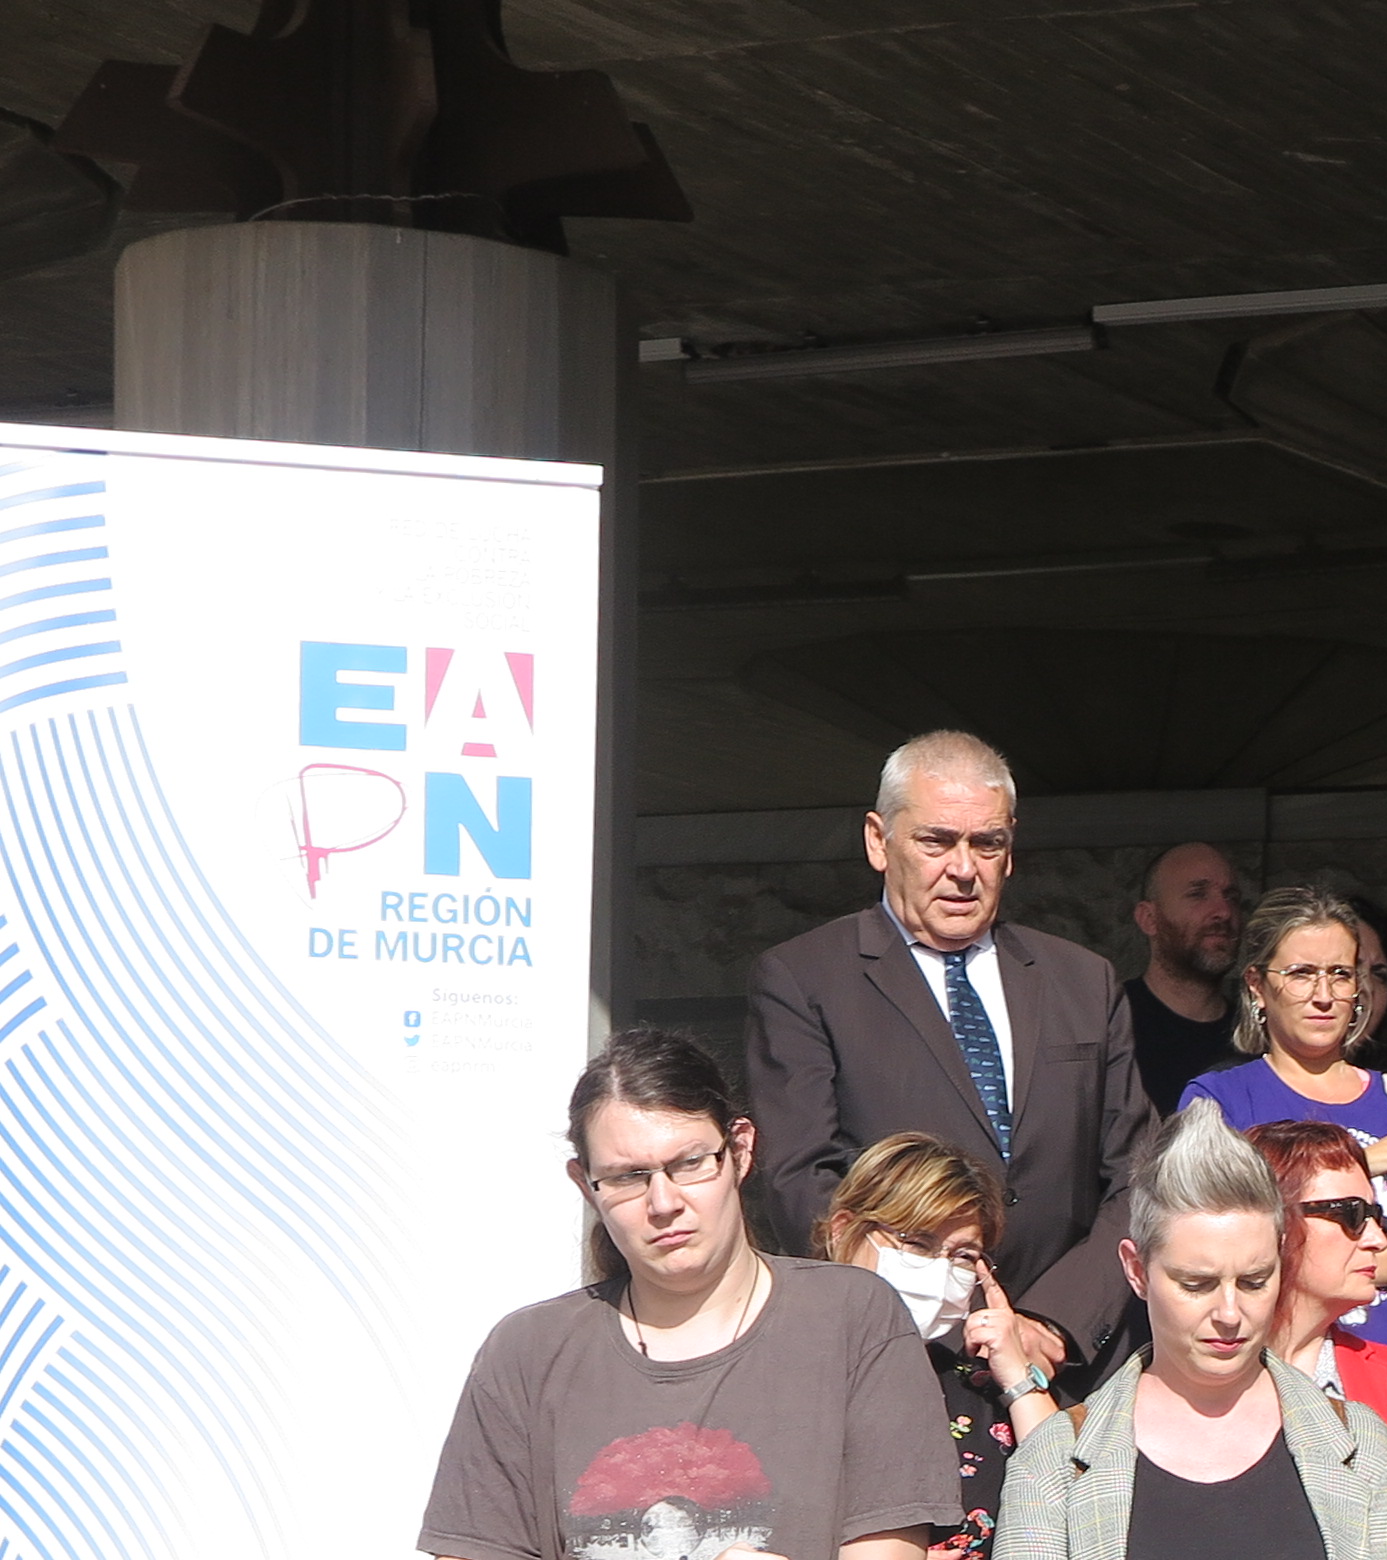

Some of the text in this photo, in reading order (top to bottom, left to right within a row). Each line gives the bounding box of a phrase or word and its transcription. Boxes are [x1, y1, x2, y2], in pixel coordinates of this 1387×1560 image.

[380, 888, 533, 928] REGIÓN
[308, 928, 533, 967] DE MURCIA
